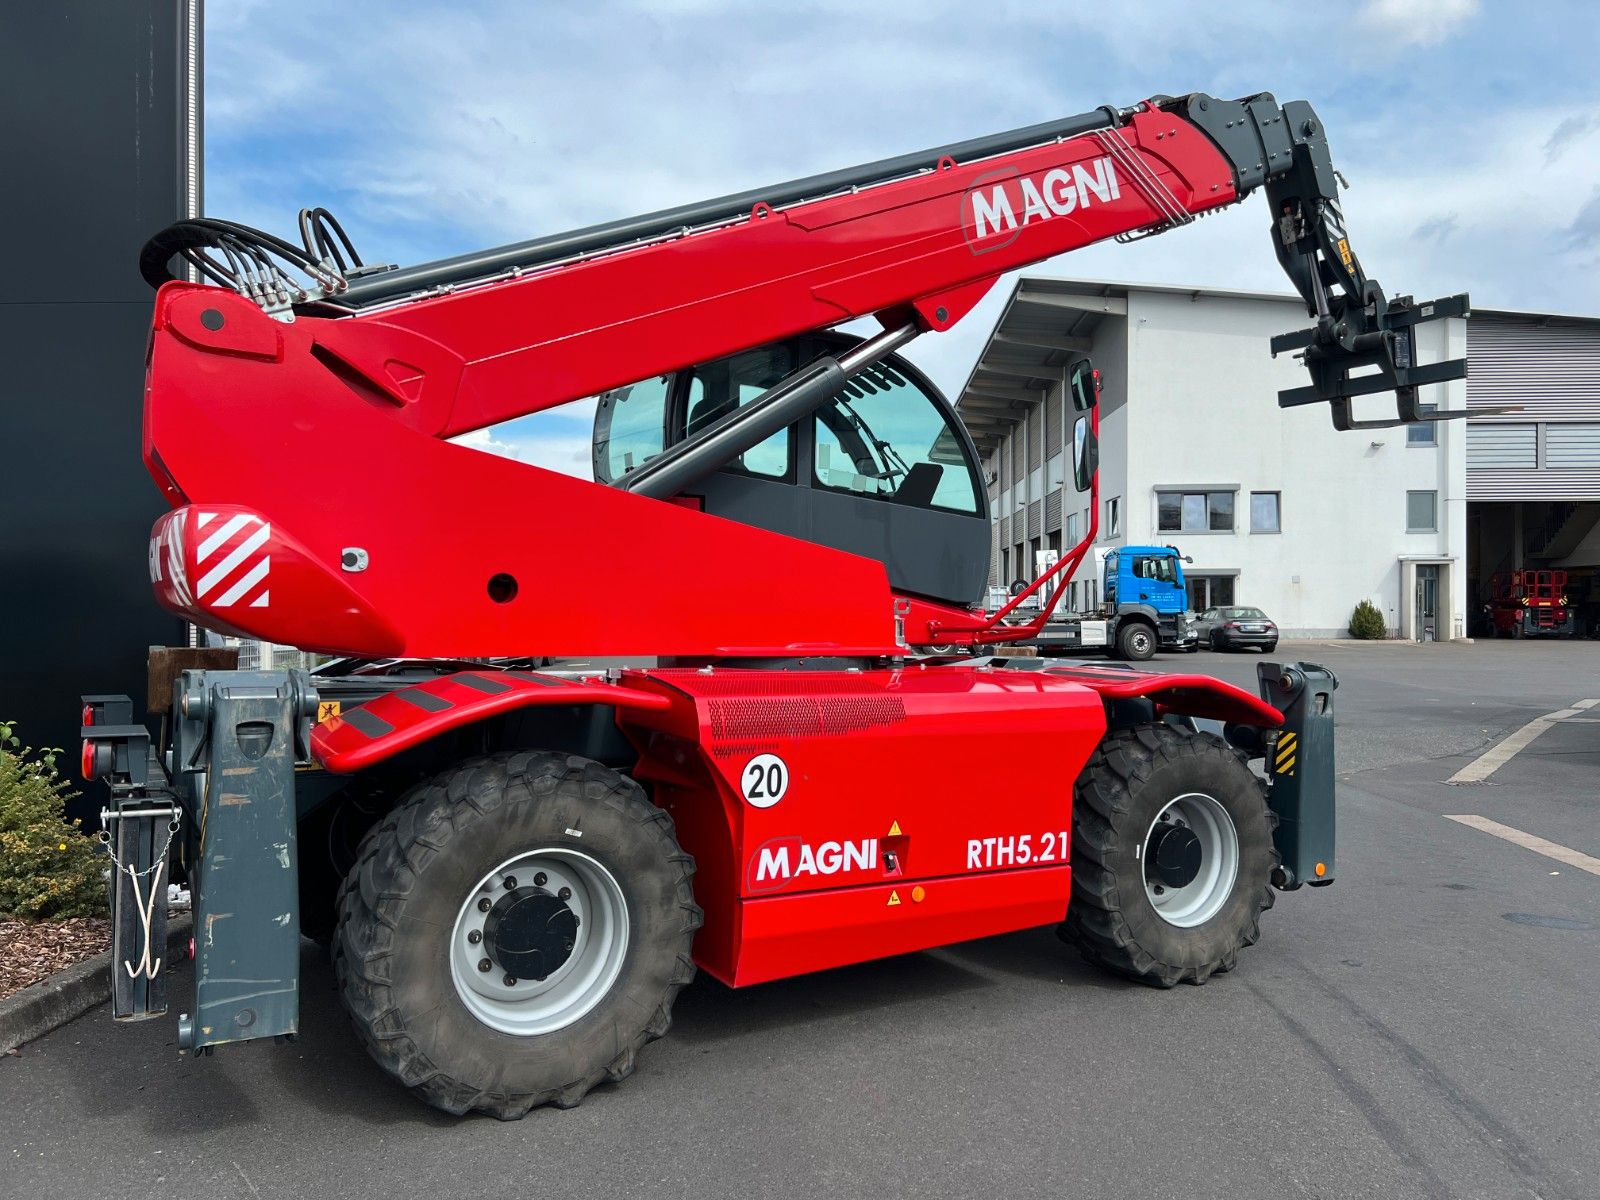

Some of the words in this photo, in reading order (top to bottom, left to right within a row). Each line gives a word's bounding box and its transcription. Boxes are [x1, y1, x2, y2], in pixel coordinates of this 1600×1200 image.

[971, 156, 1120, 239] MAGNI
[748, 763, 782, 798] 20
[756, 838, 878, 881] MAGNI
[967, 832, 1067, 869] RTH5.21
